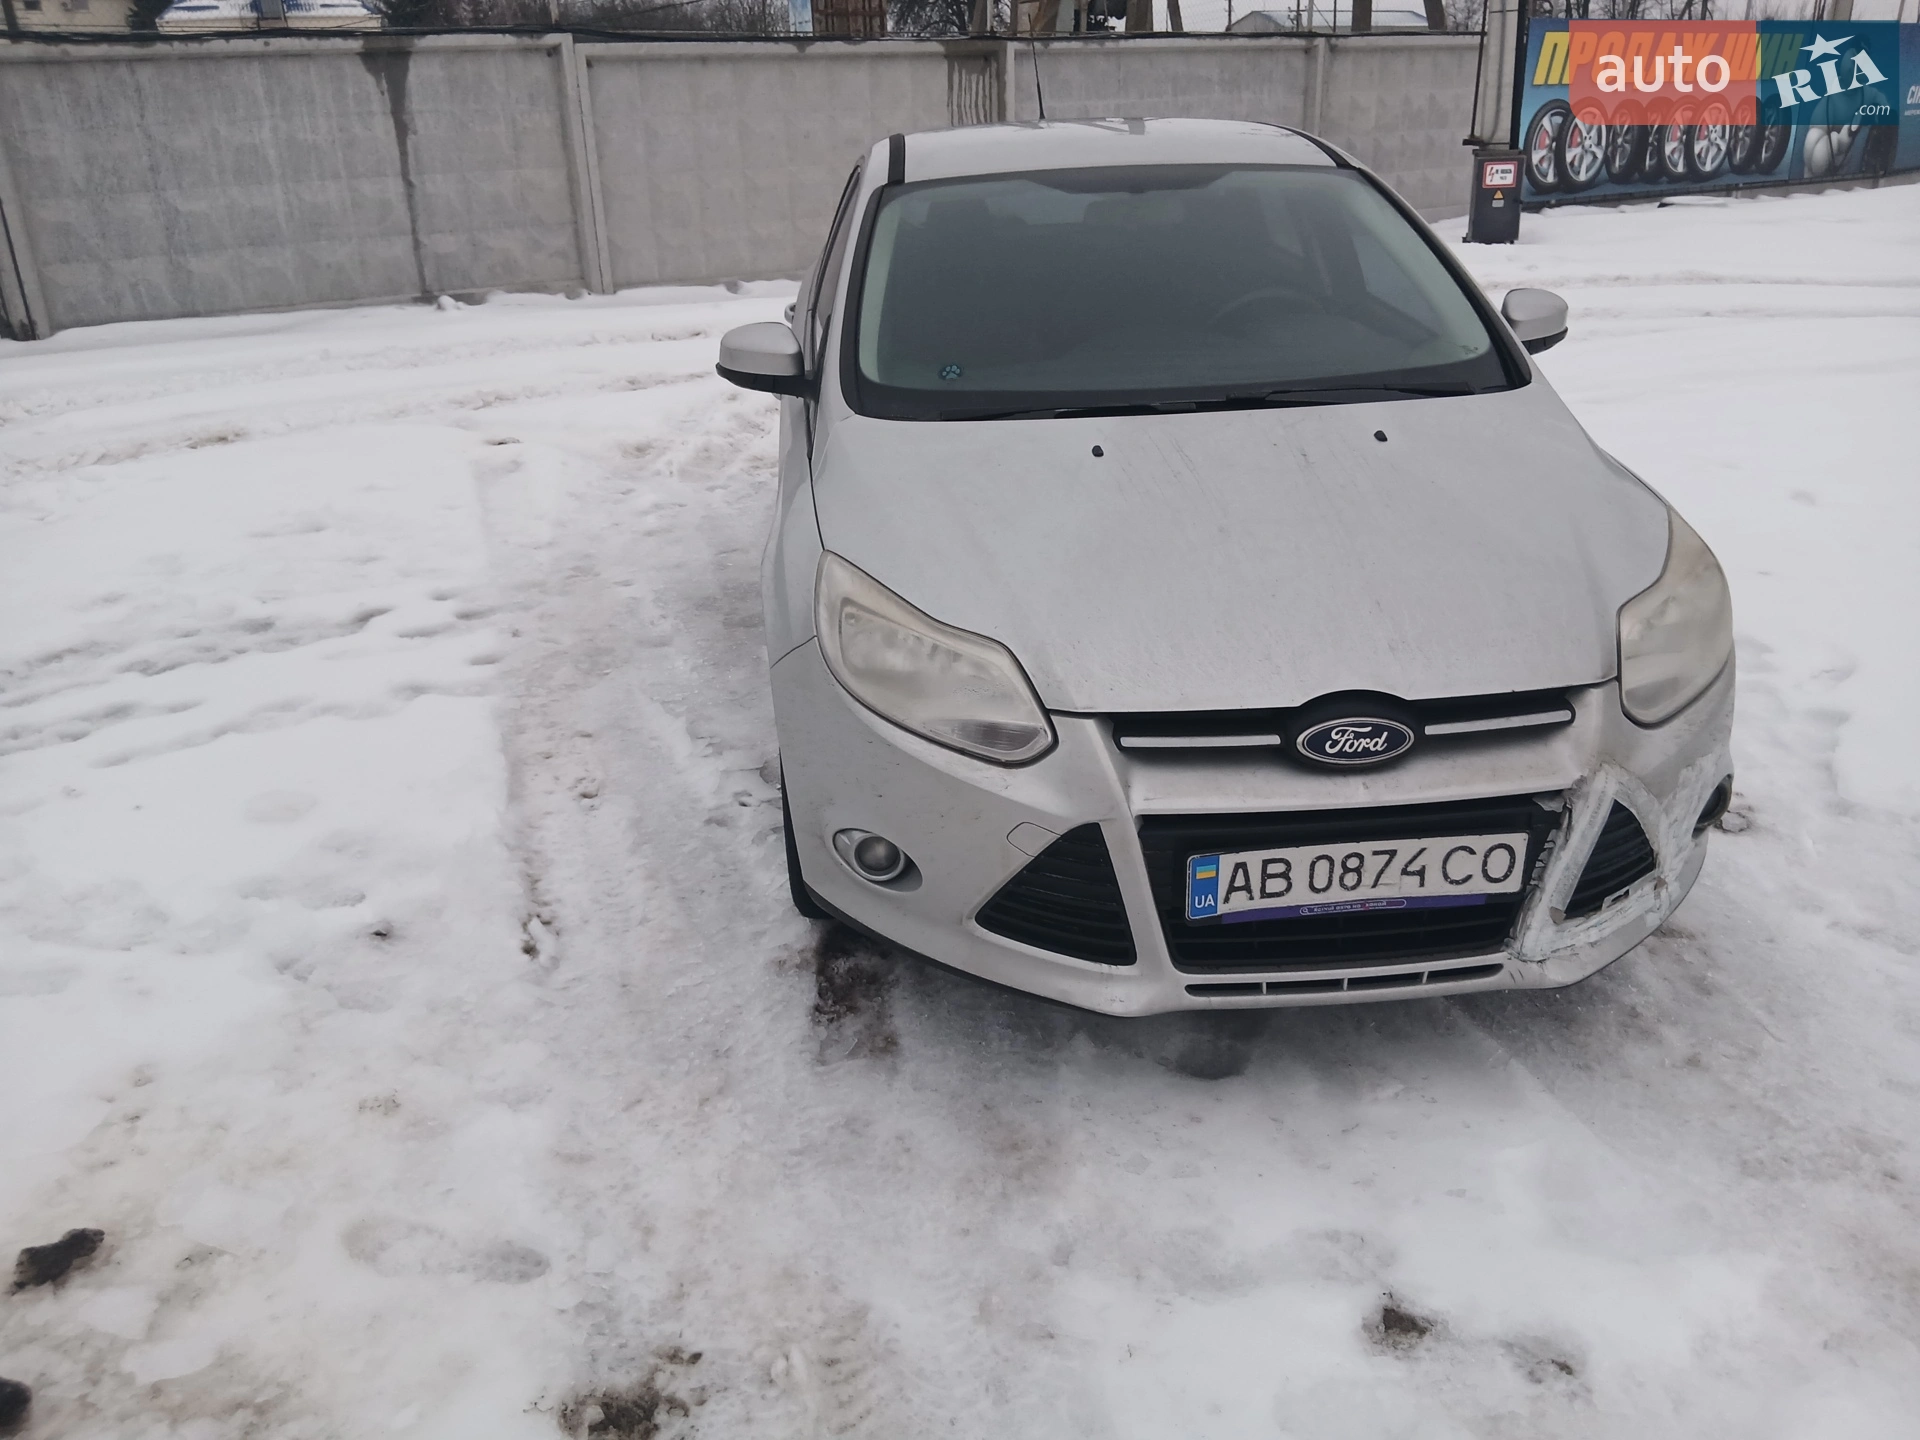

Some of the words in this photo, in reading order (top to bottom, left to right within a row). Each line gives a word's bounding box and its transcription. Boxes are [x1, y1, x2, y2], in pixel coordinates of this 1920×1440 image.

[1325, 726, 1389, 754] Ford
[1223, 857, 1293, 904] AB
[1308, 847, 1428, 894] 0874
[1441, 842, 1516, 886] CO
[1194, 893, 1215, 909] UA
